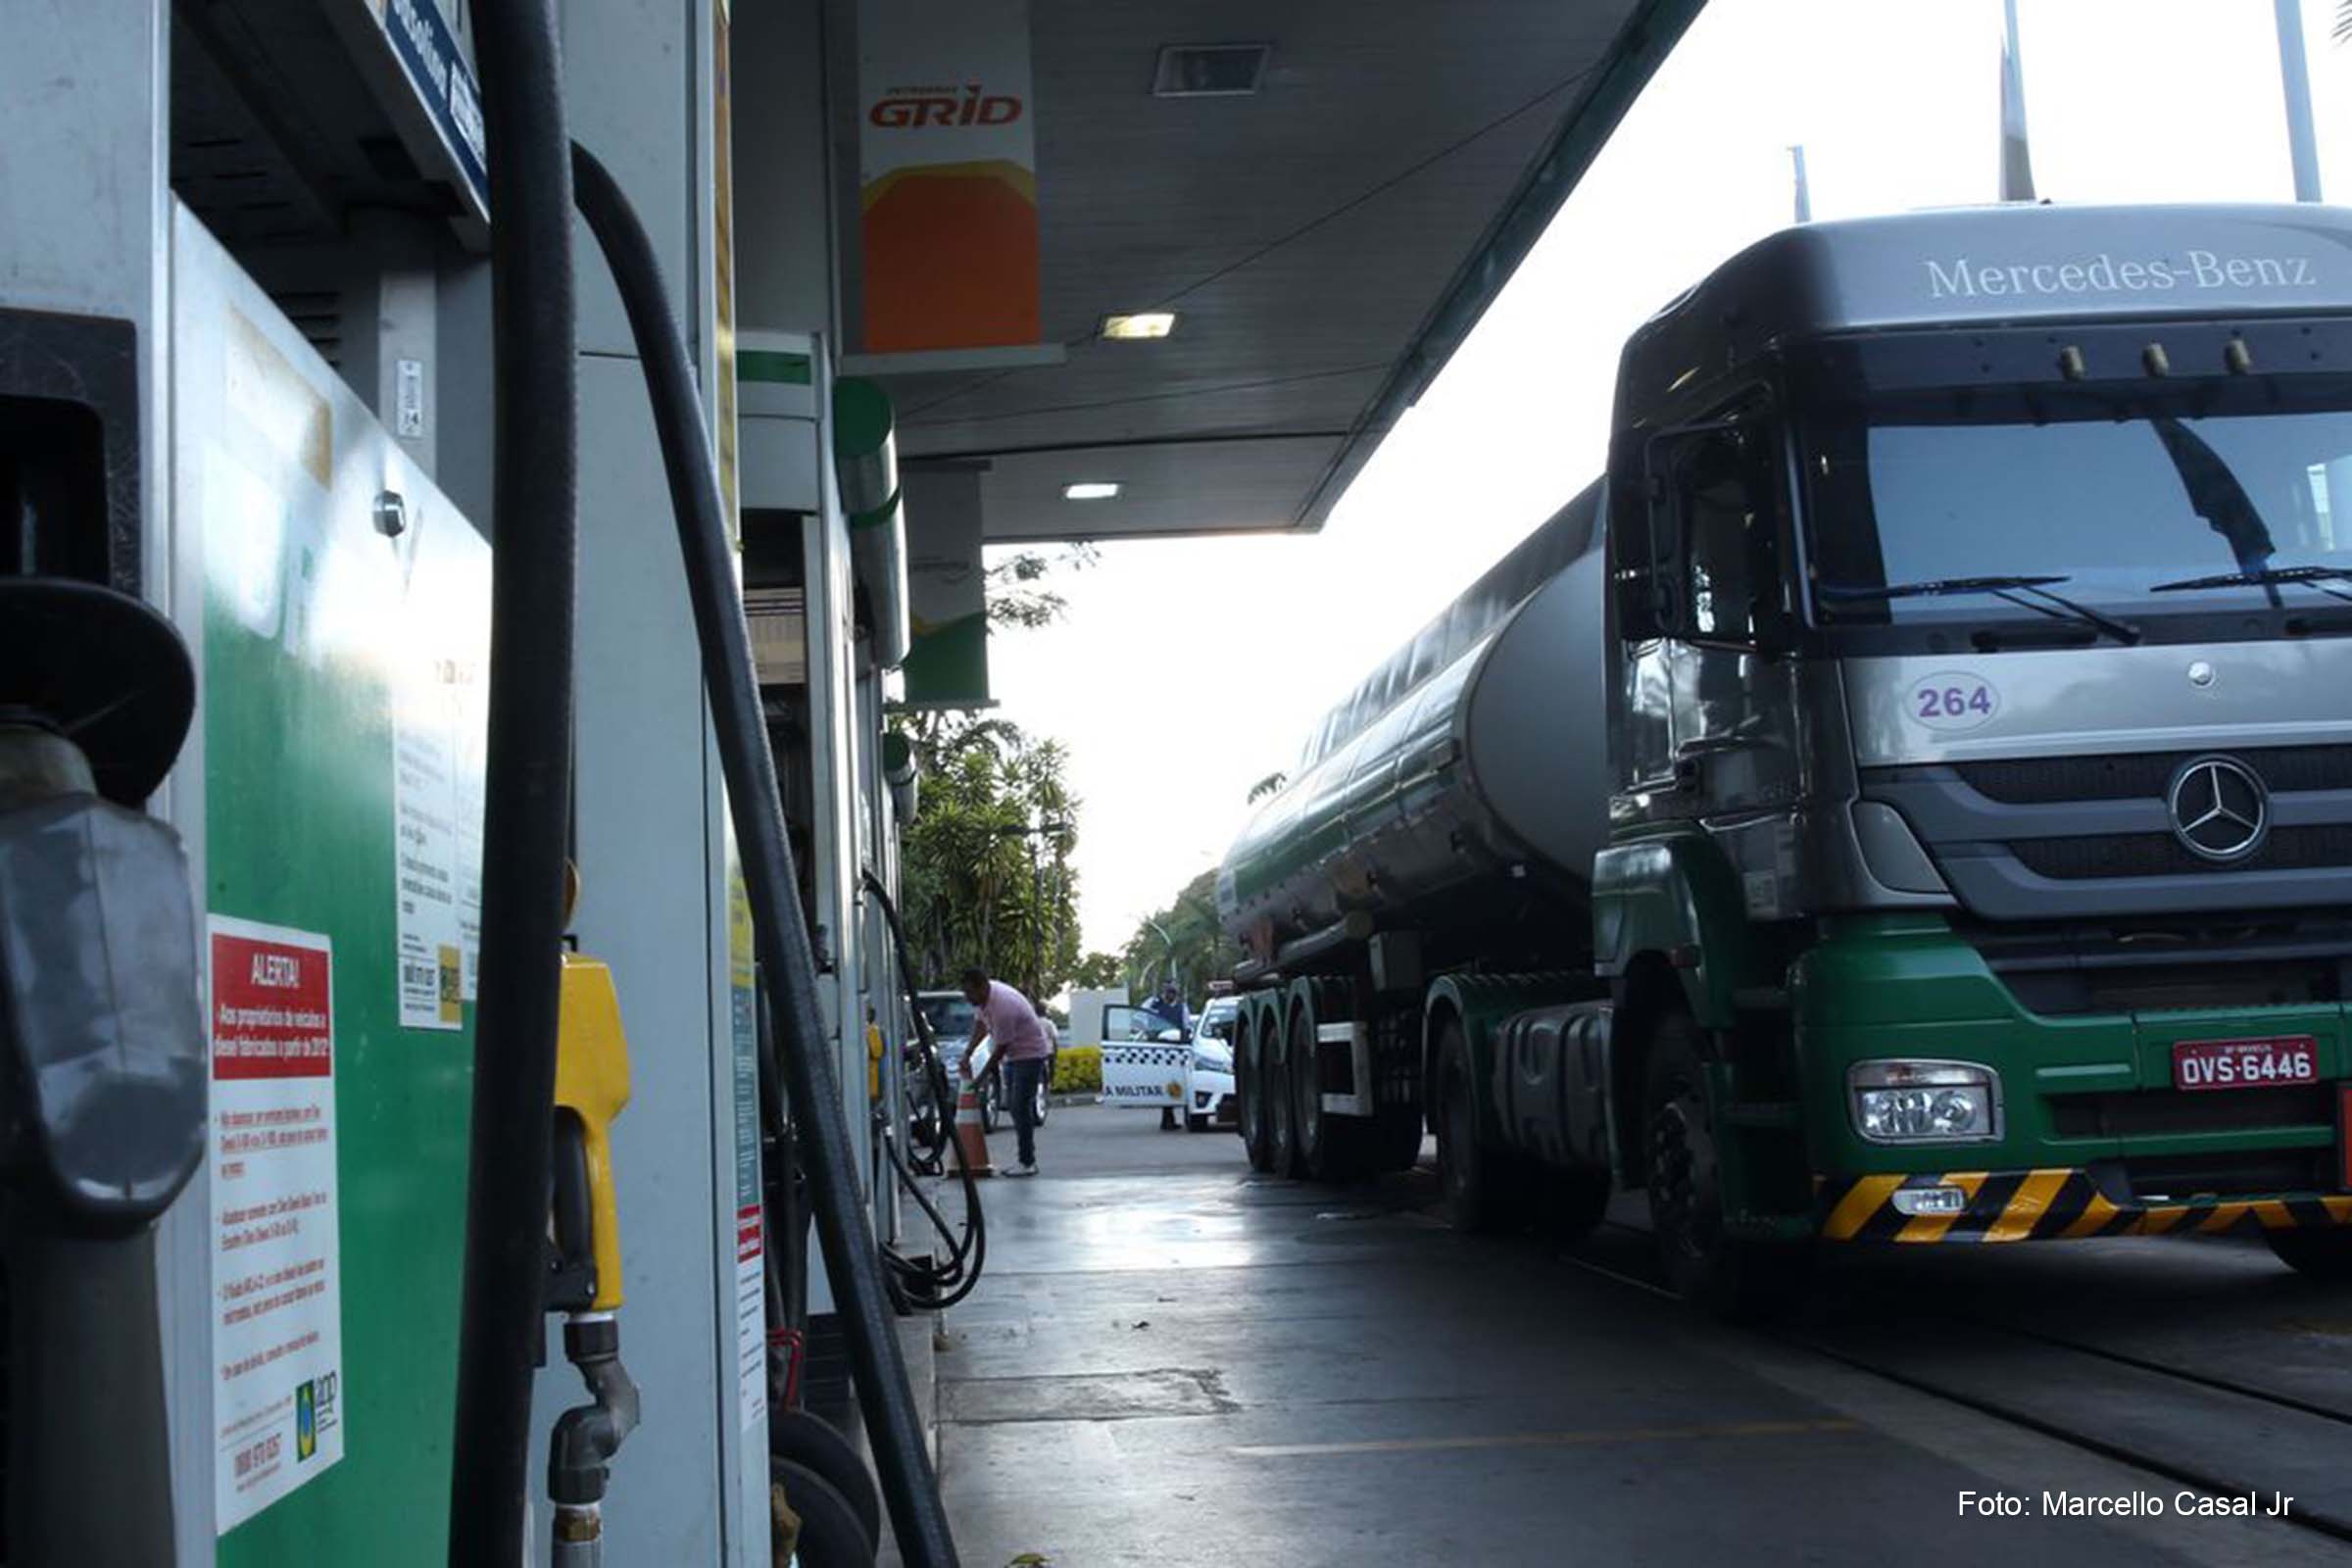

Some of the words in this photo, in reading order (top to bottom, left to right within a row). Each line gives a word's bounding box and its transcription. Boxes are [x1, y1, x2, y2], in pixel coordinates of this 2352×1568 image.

[1924, 250, 2316, 298] Mercedes-Benz
[1918, 686, 1990, 716] 264
[1115, 1085, 1164, 1097] MILITAR
